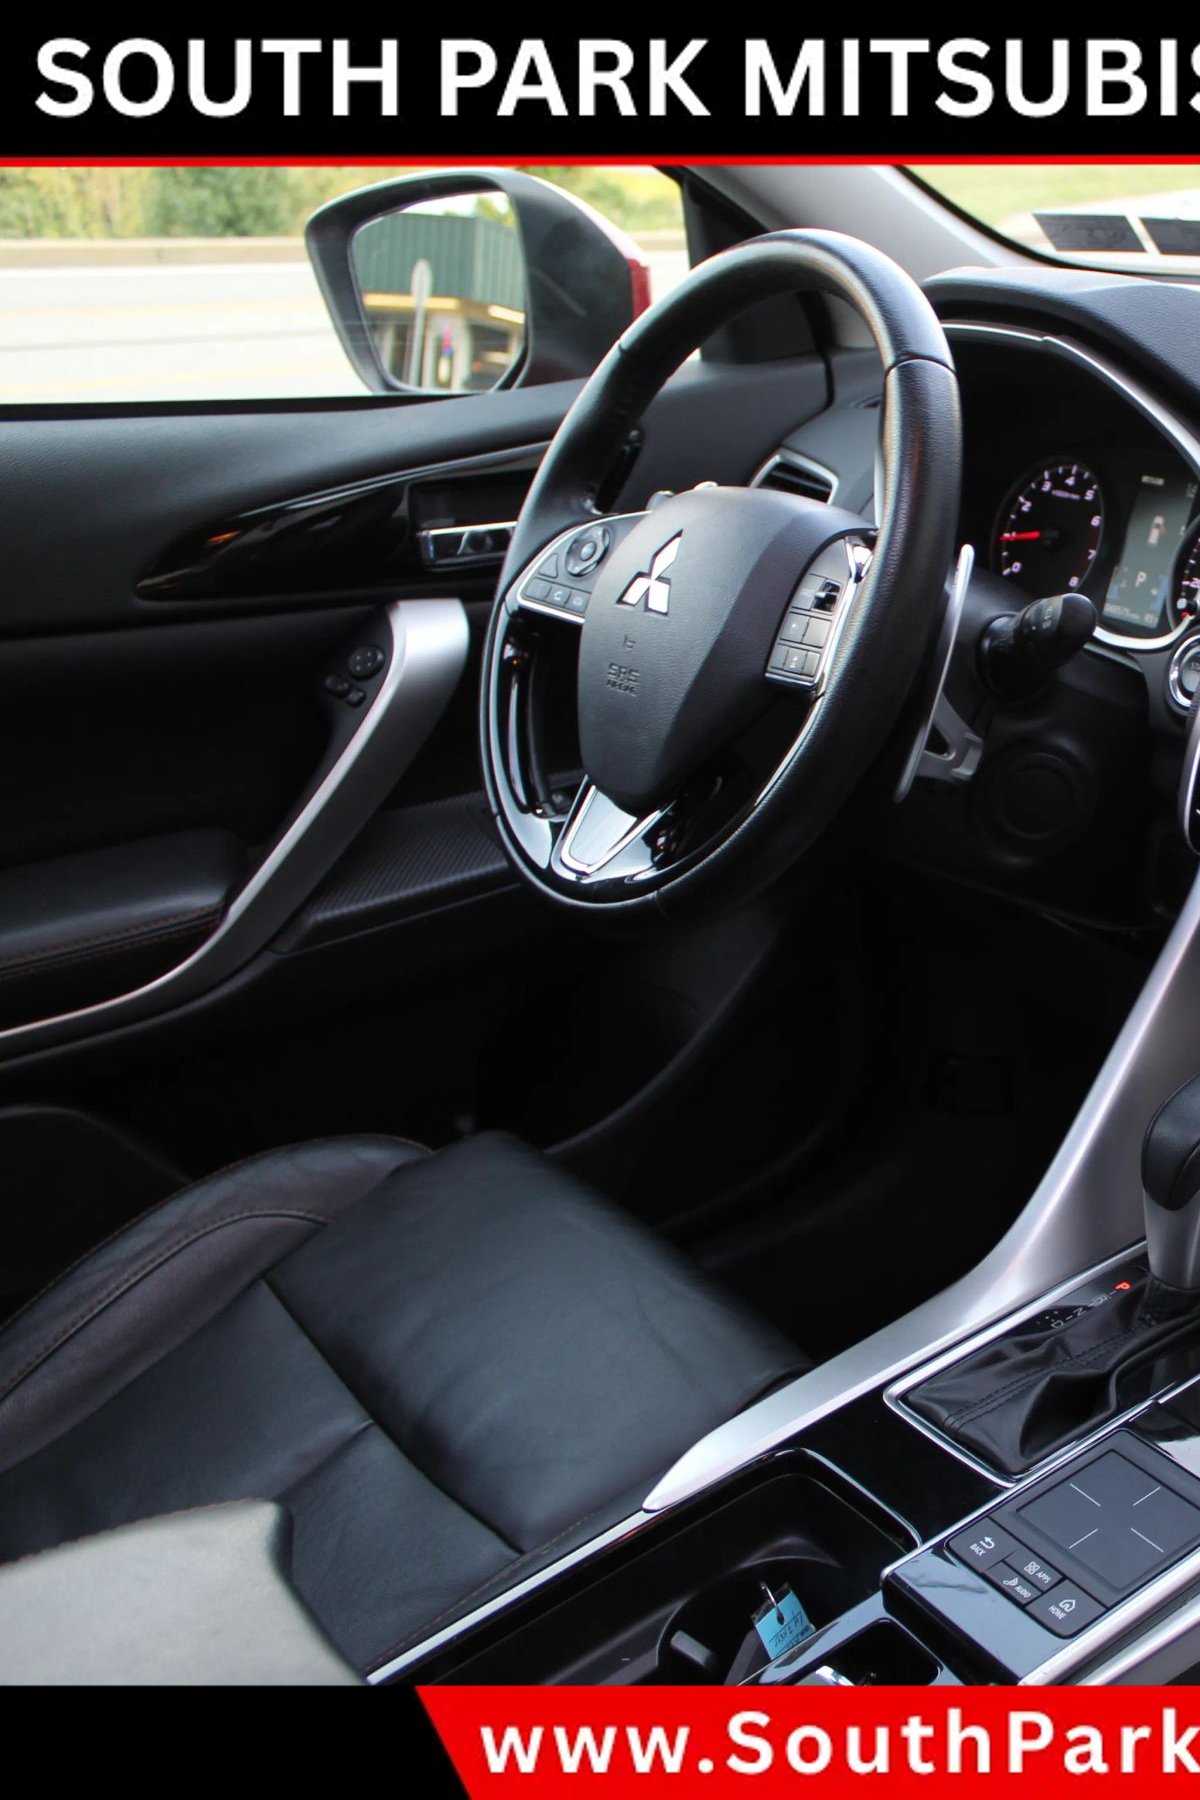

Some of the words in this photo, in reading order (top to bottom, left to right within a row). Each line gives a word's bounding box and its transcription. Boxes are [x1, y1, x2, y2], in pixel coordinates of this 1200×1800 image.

[1041, 480, 1052, 492] 3
[1065, 476, 1075, 486] 4
[1084, 490, 1095, 501] 5
[1021, 500, 1032, 512] 2
[1090, 515, 1101, 527] 6
[1087, 549, 1097, 560] 7
[1011, 562, 1022, 573] 0
[1068, 576, 1079, 587] 8
[1135, 571, 1147, 587] P
[1115, 1281, 1131, 1291] P
[1050, 1319, 1065, 1330] D
[969, 1543, 986, 1557] BACK
[1035, 1570, 1052, 1584] APPS
[1014, 1584, 1032, 1599] AUDIO
[1048, 1604, 1066, 1620] HOME
